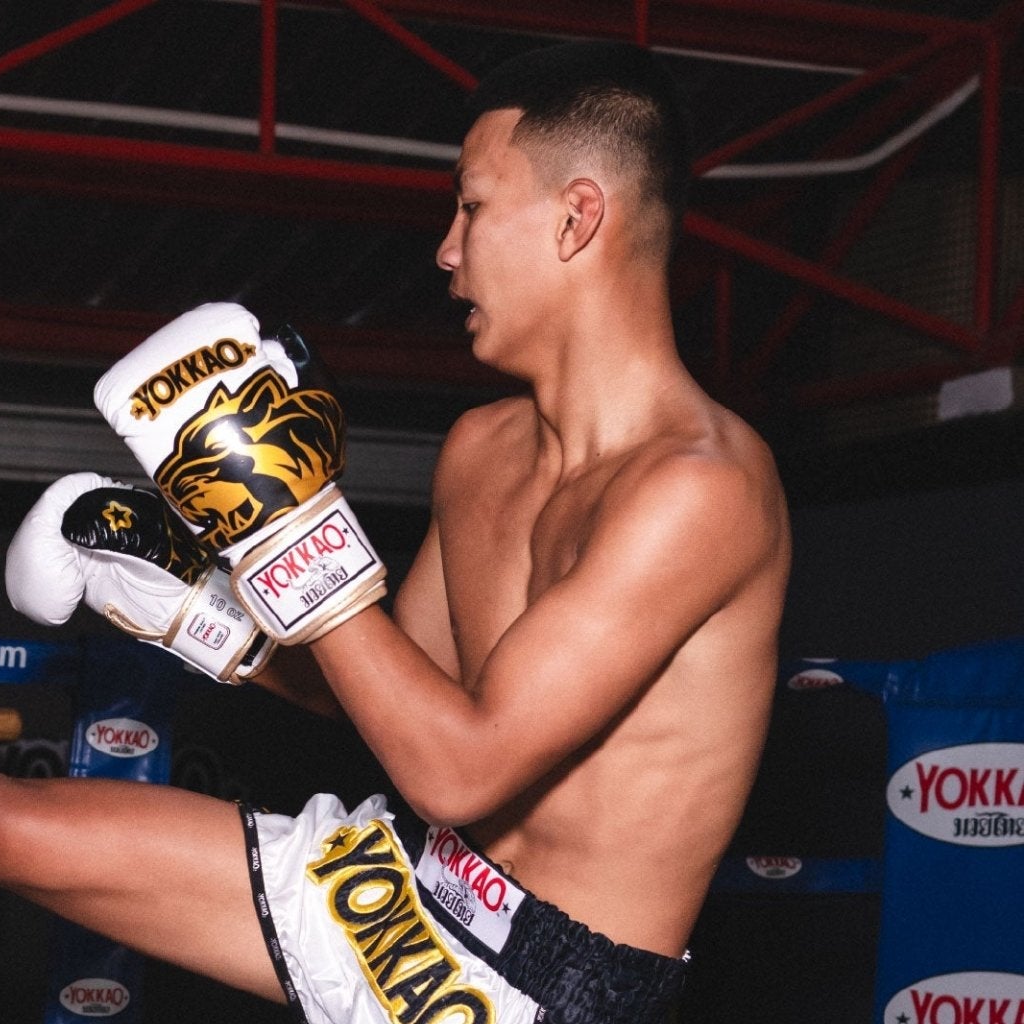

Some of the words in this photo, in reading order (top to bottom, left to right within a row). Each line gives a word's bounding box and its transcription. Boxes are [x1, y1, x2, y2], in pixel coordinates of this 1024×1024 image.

[131, 339, 245, 418] YOKKAO
[257, 524, 346, 598] YOKKAO
[209, 593, 227, 612] 10
[96, 724, 150, 749] YOKKAO
[430, 827, 506, 912] YOKKAO
[69, 986, 124, 1006] YOKKAO
